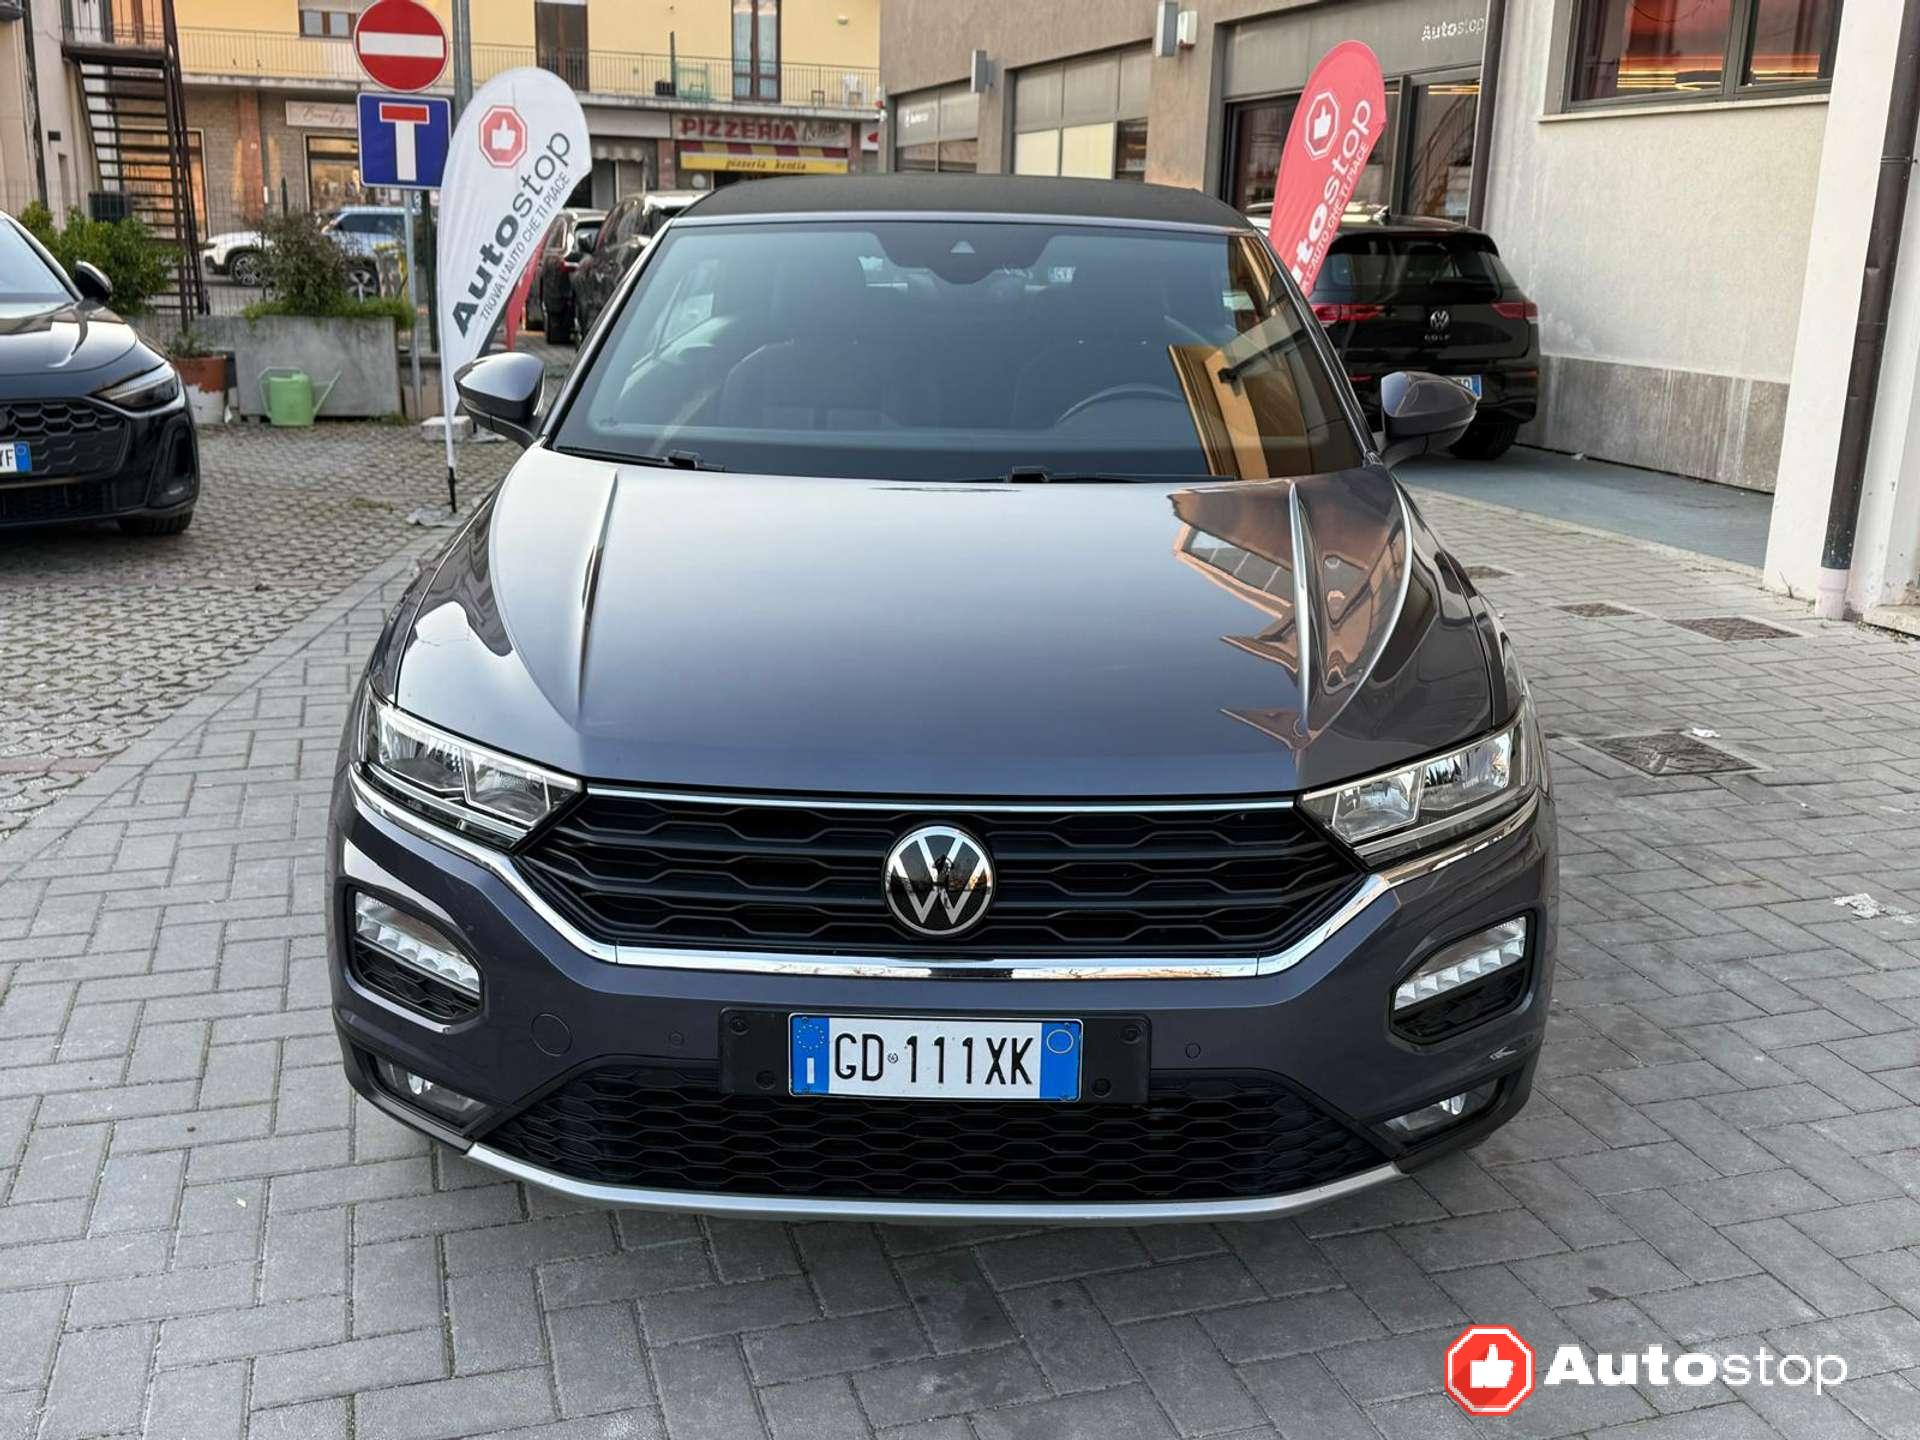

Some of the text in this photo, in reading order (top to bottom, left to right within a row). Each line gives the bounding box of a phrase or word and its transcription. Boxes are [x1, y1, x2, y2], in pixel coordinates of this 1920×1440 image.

[1421, 17, 1485, 42] Autostop
[680, 117, 797, 142] PIZZERIA
[1291, 99, 1372, 285] tostop
[452, 132, 571, 338] Autostop
[479, 281, 505, 321] TROVA
[498, 241, 526, 284] L'AUTO
[521, 217, 541, 243] CHE
[543, 171, 570, 208] PIACE
